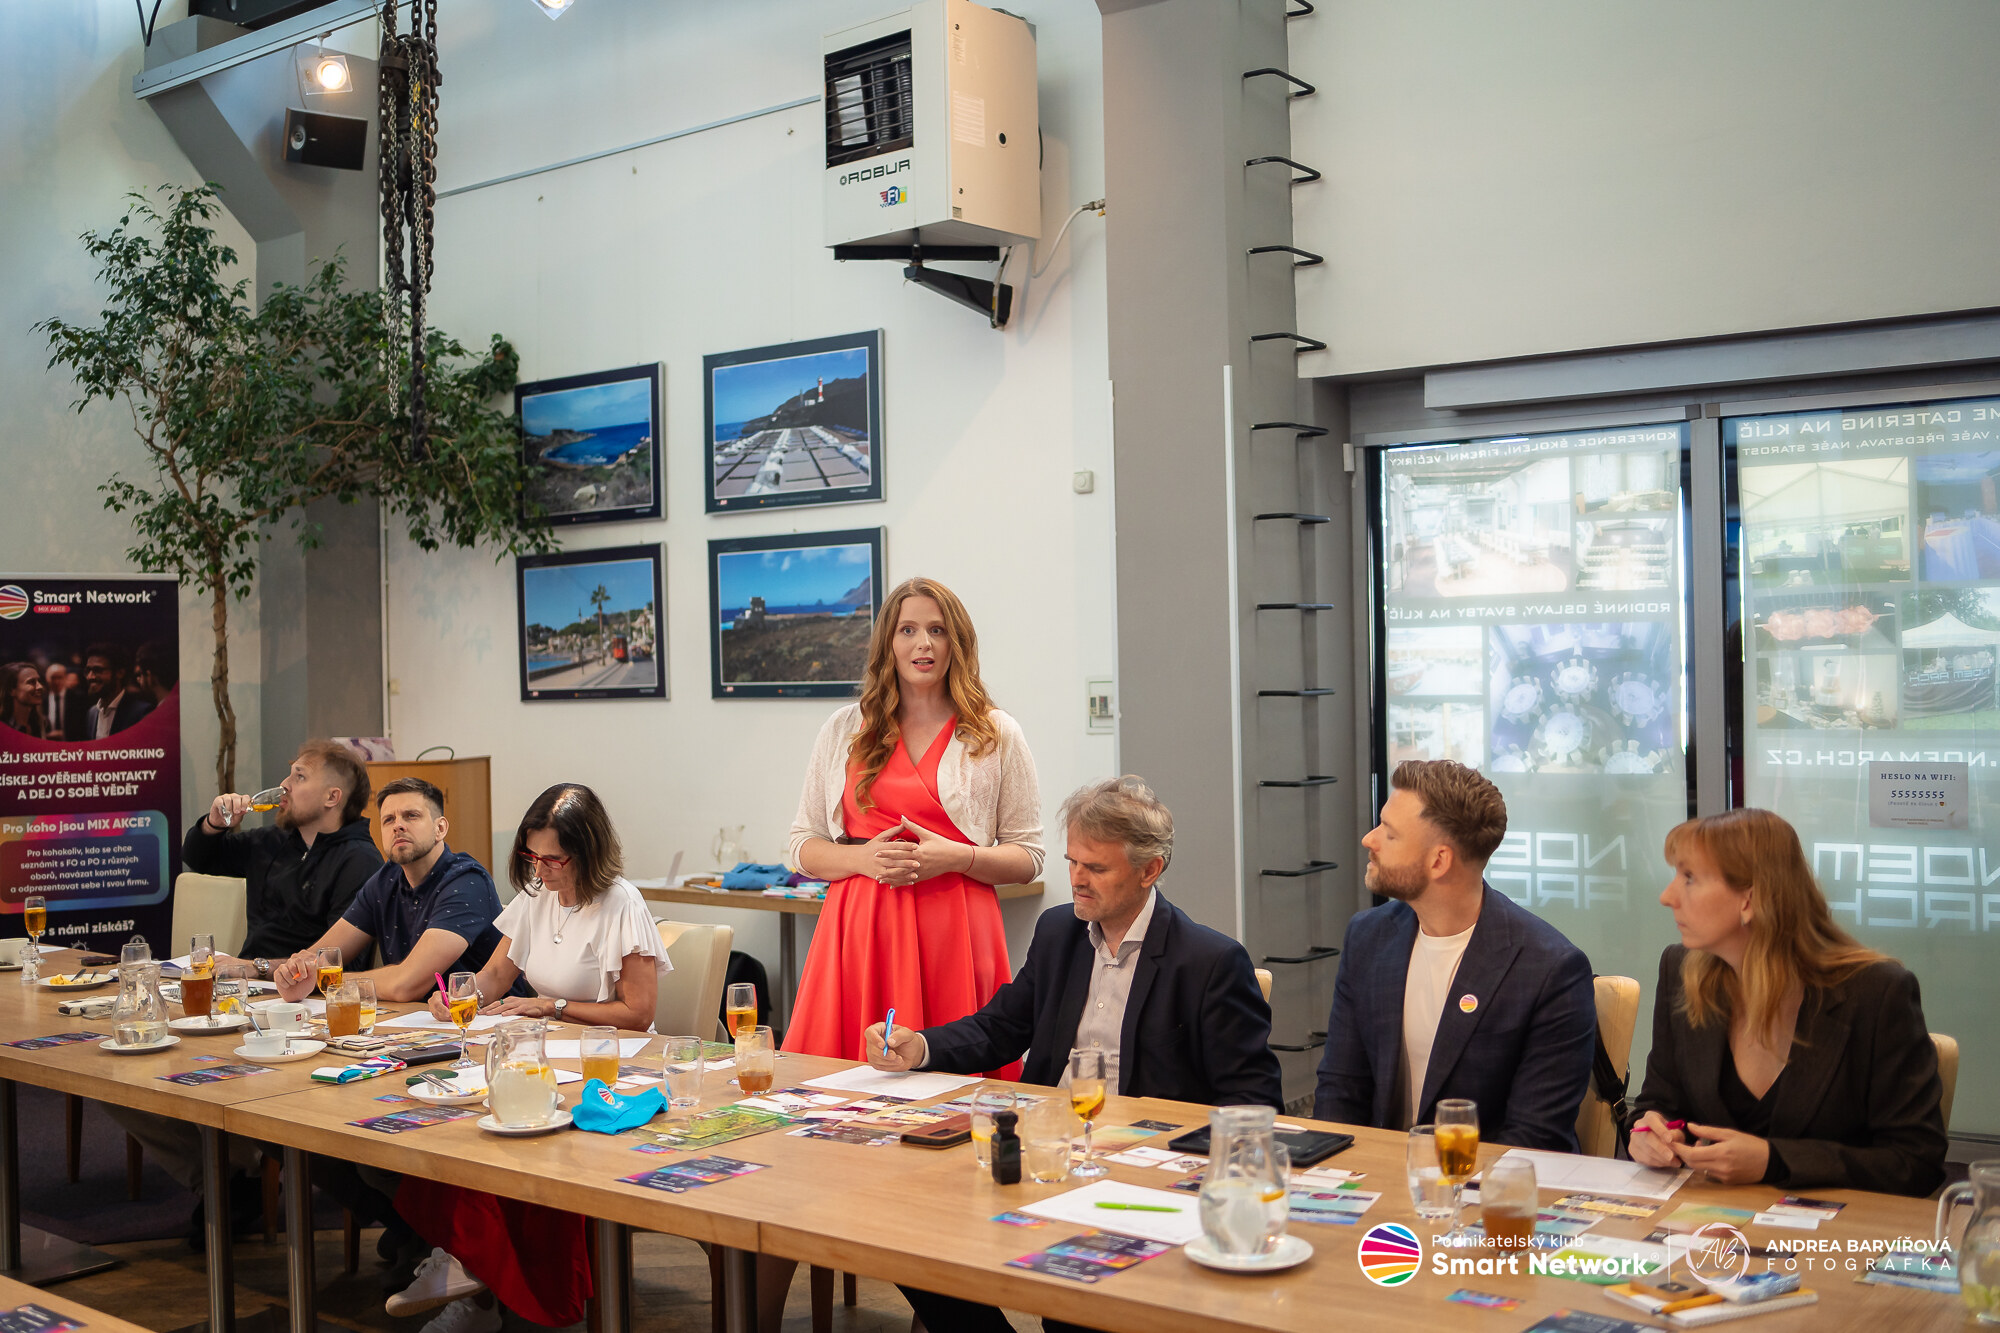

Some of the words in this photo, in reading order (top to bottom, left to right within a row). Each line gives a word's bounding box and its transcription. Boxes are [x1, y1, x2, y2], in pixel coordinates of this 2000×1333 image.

[33, 590, 82, 603] Smart
[22, 749, 84, 763] SKUTEČNÝ
[86, 748, 165, 761] NETWORKING
[0, 773, 36, 786] ÍSKEJ
[37, 770, 93, 784] OVĚŘENÉ
[95, 769, 157, 783] KONTAKTY
[17, 789, 27, 800] A
[29, 788, 53, 800] DEJ
[54, 788, 65, 799] O
[67, 784, 100, 798] SOBĚ
[101, 782, 139, 797] VĚDĚT
[1890, 790, 1945, 799] 55555555
[2, 823, 24, 834] Pro
[26, 822, 56, 833] koho
[58, 820, 84, 834] jsou
[87, 818, 110, 830] MIX
[112, 816, 152, 829] AKCE?
[26, 849, 41, 858] Pro
[42, 847, 83, 857] kohokoliv,
[85, 846, 100, 855] kdo
[113, 844, 132, 853] chce
[20, 860, 58, 870] seznámit
[66, 859, 78, 867] FO
[87, 858, 100, 866] PO
[108, 855, 139, 866] různých
[30, 871, 58, 881] oborů,
[59, 869, 93, 879] navázat
[94, 868, 130, 877] kontakty
[18, 883, 79, 894] odprezentovat
[81, 881, 100, 889] sebe
[107, 880, 125, 888] svou
[126, 878, 149, 887] firmu.
[48, 927, 55, 936] s
[58, 922, 89, 935] námi
[91, 919, 135, 934] získáš?
